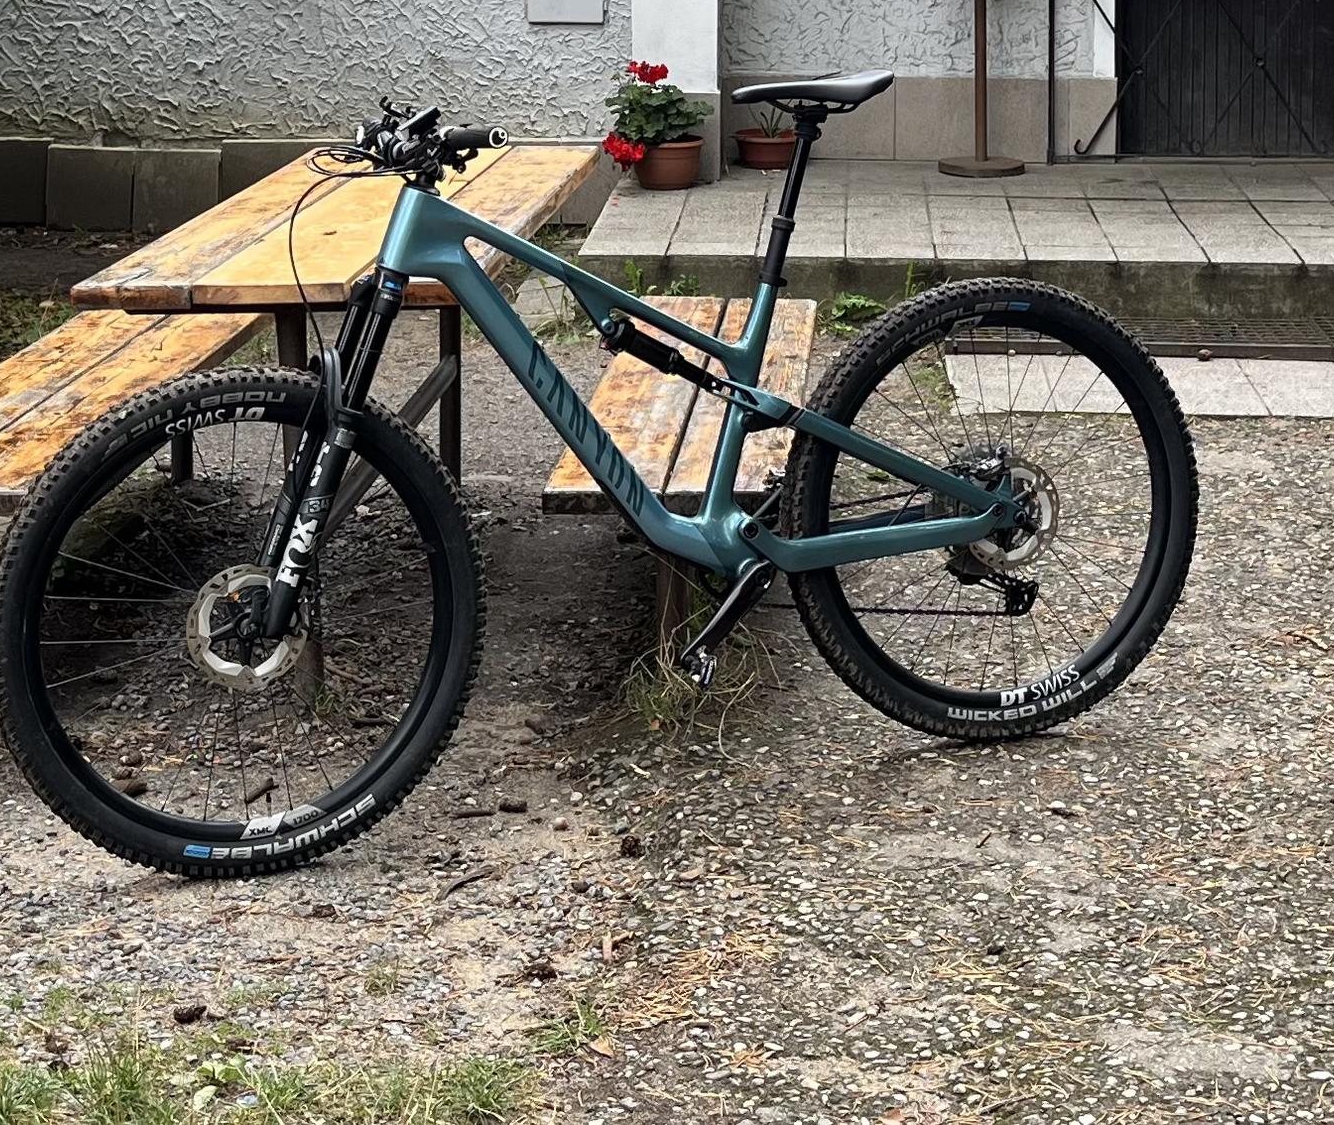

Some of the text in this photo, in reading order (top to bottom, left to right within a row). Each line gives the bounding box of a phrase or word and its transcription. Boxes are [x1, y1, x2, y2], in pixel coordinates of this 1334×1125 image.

[165, 406, 266, 438] DT SWISS
[181, 391, 287, 414] NOBBY
[275, 513, 319, 588] FOX
[946, 678, 1098, 722] WICKED WILL
[1000, 663, 1081, 708] DT SWISS
[211, 793, 377, 860] SCHWALBE
[292, 810, 319, 826] 1700
